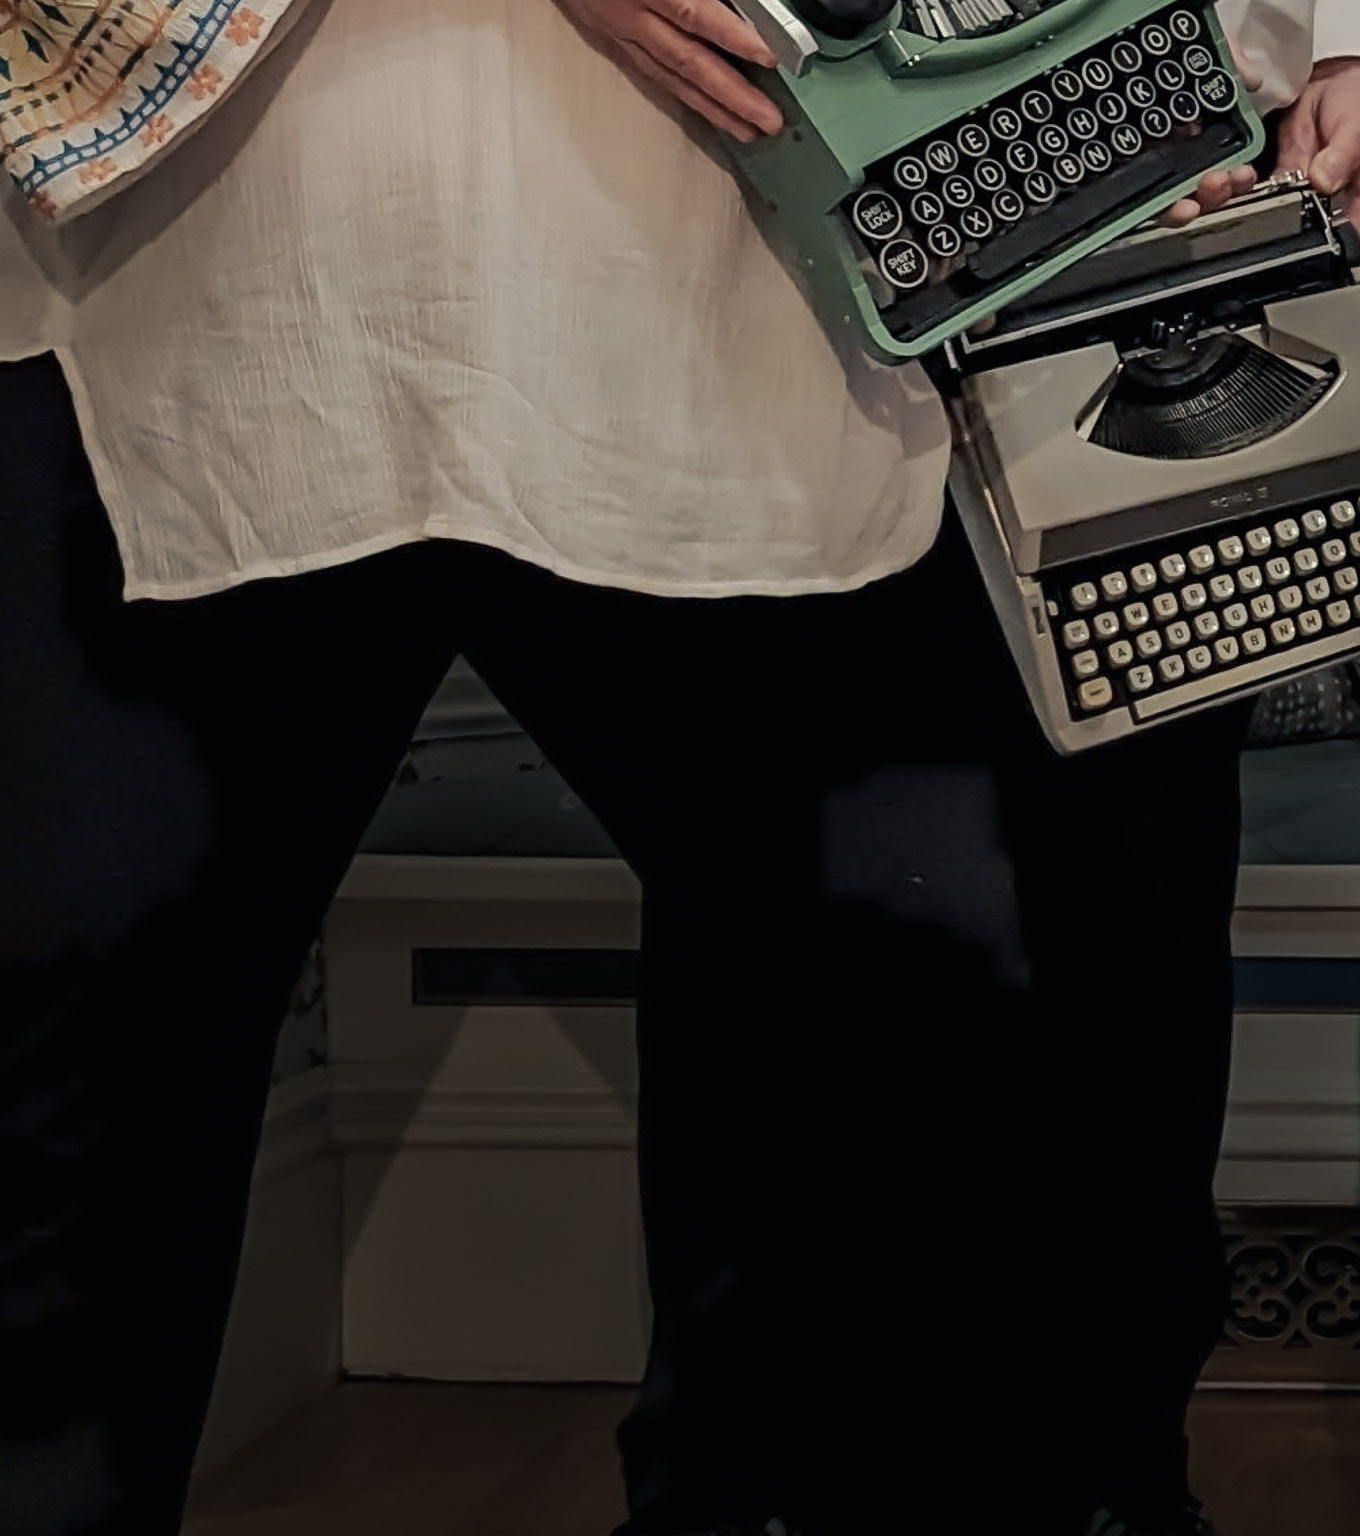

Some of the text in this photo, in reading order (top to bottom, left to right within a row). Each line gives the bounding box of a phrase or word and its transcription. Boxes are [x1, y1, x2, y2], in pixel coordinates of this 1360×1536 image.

[902, 164, 922, 183] Q
[931, 146, 952, 166] W
[966, 131, 982, 149] E
[997, 114, 1015, 133] R
[1029, 97, 1044, 115] T
[1058, 76, 1074, 93] Y
[1089, 64, 1106, 82] U
[1147, 32, 1164, 50] O
[1176, 17, 1189, 34] P
[1210, 85, 1227, 101] KEY
[922, 68, 1179, 218] A S D F G H J K L
[867, 209, 895, 230] LOCK
[936, 231, 953, 249] Z
[967, 212, 985, 230] X
[1000, 196, 1016, 213] C
[1031, 176, 1046, 194] V
[1061, 159, 1076, 175] B
[1088, 146, 1105, 164] N
[1117, 129, 1136, 148] M
[896, 261, 917, 276] KEY
